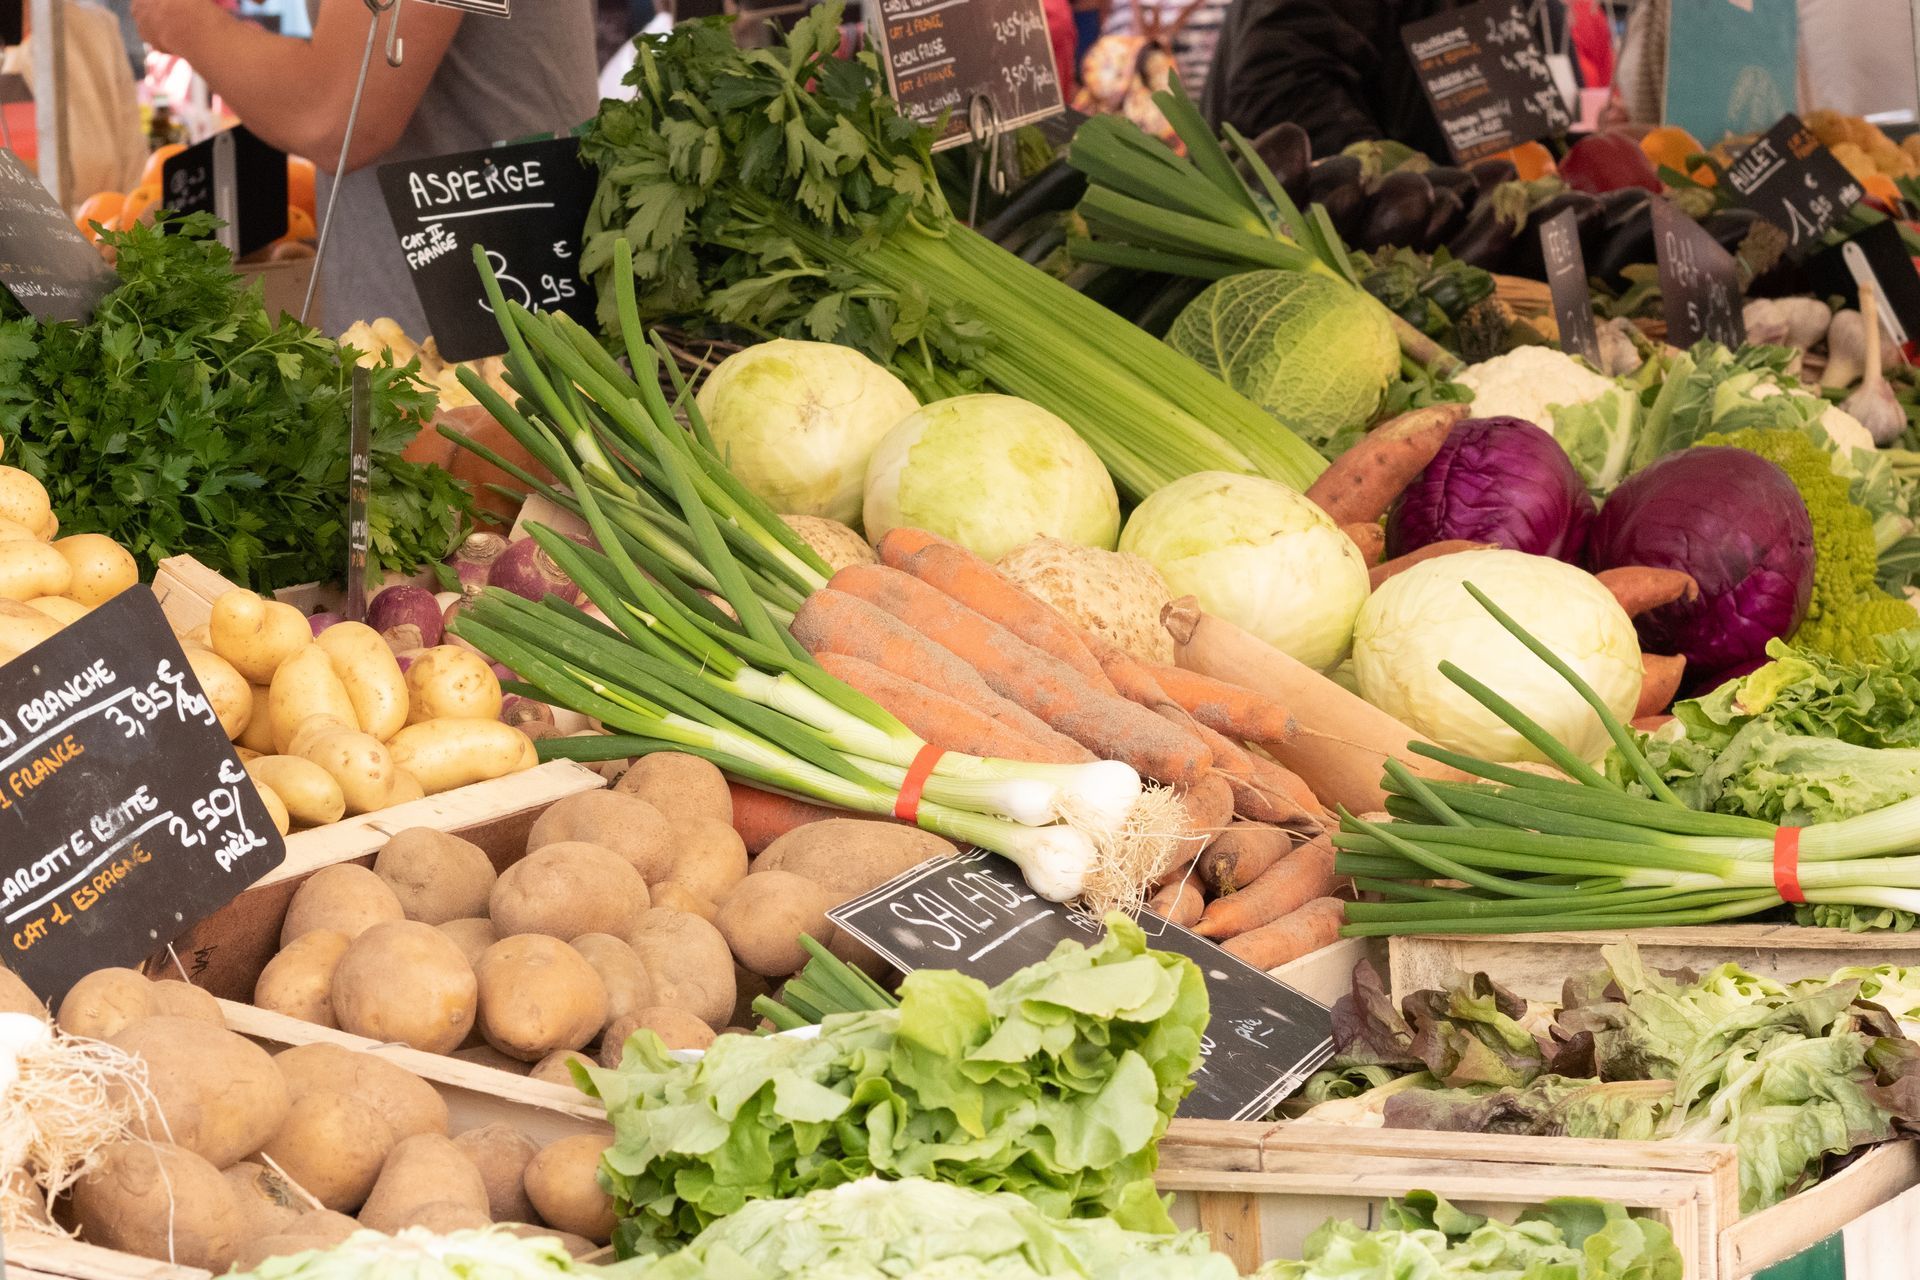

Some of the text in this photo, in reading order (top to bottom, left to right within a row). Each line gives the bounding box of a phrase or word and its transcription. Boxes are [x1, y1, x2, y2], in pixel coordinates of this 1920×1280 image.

[409, 161, 545, 208] ASPERGE
[1729, 138, 1778, 194] AILLET
[401, 233, 427, 250] CAT
[553, 241, 572, 258] €
[17, 658, 116, 733] BRANCHE
[9, 735, 84, 797] FRANCE
[90, 785, 158, 842] BOTTE
[13, 842, 152, 950] CAT 1 ESPAGNE
[889, 869, 1037, 951] SALADE
